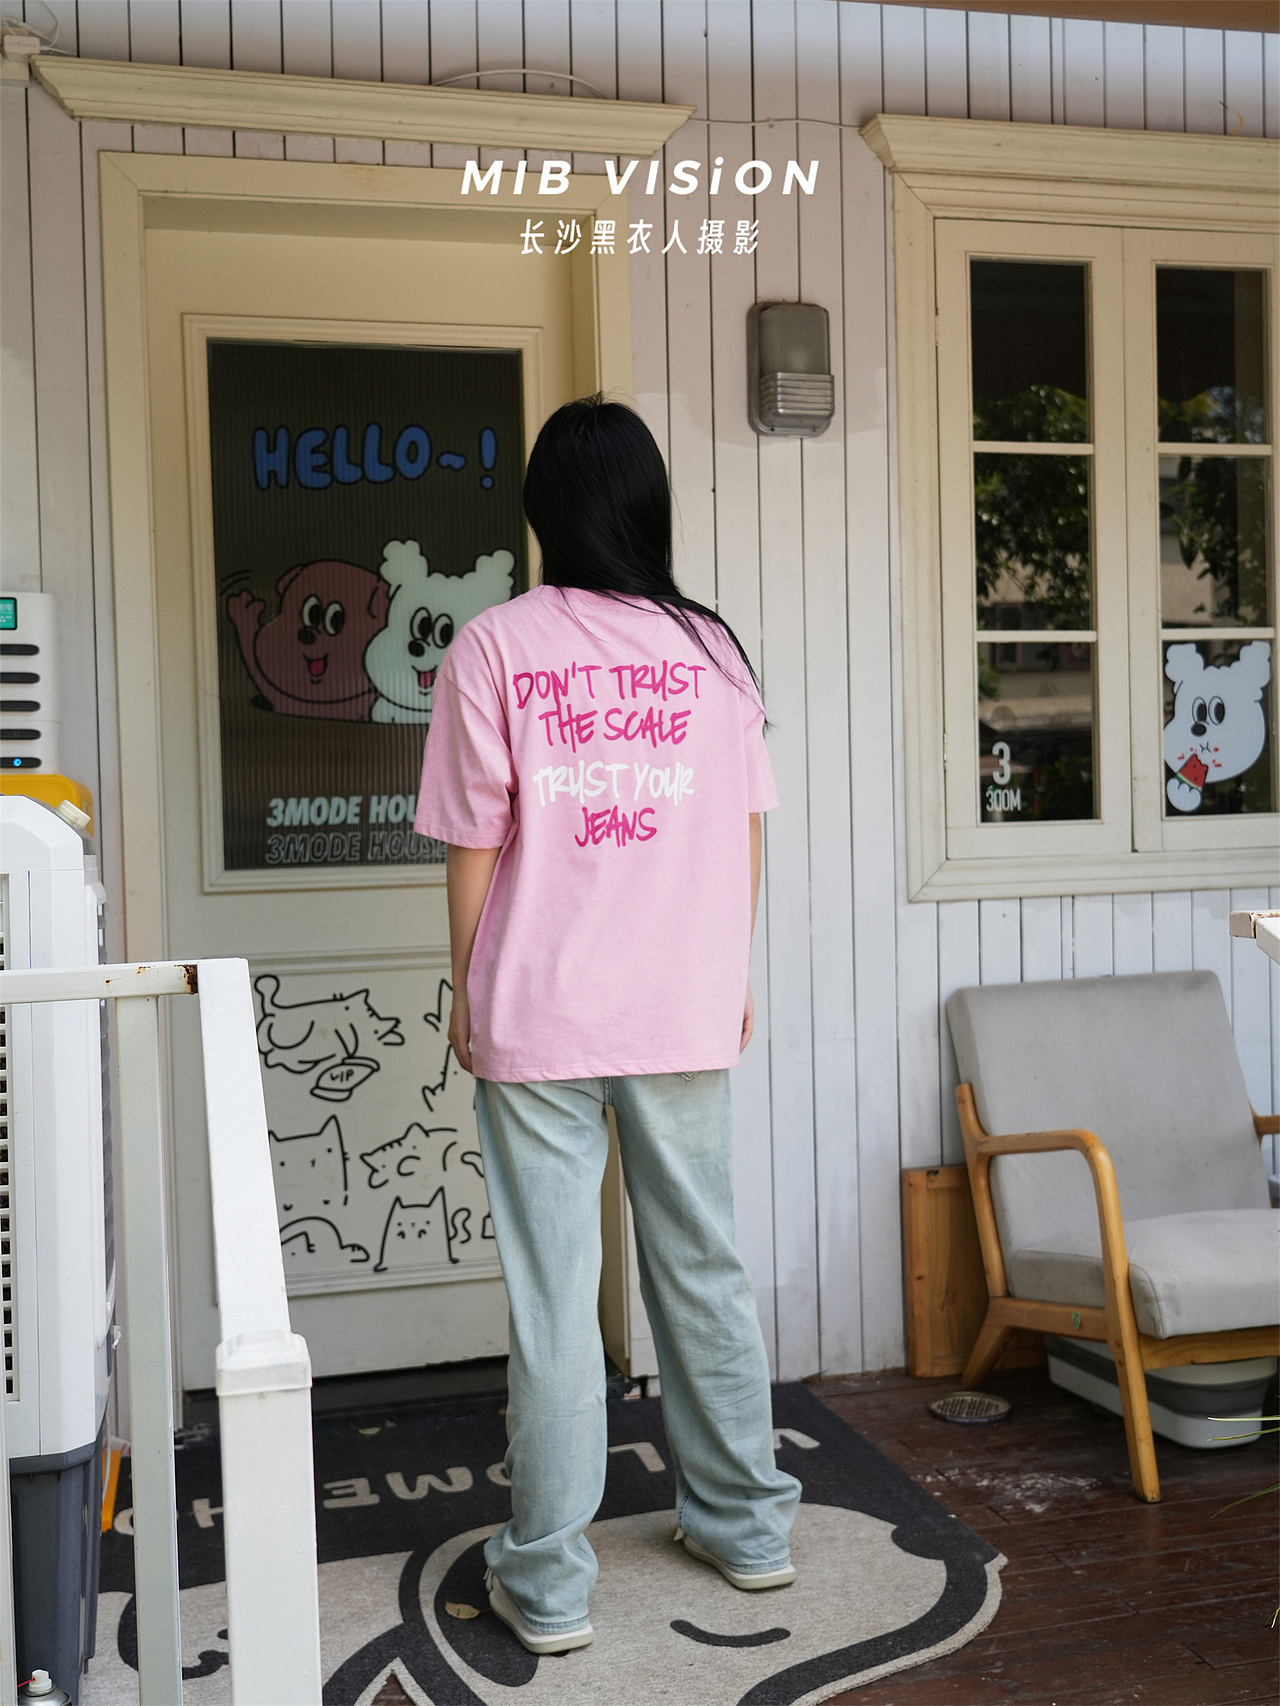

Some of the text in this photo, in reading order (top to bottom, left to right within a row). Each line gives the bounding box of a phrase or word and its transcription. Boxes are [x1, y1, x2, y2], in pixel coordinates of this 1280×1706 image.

[513, 659, 707, 709] DON'T TRUST
[538, 703, 691, 753] THE SCALE
[533, 760, 694, 807] TRUST YOUR
[266, 793, 418, 828] 3MODE HOU
[574, 805, 657, 848] JEANS
[266, 831, 362, 865] 3MODE
[330, 1069, 354, 1082] VIP
